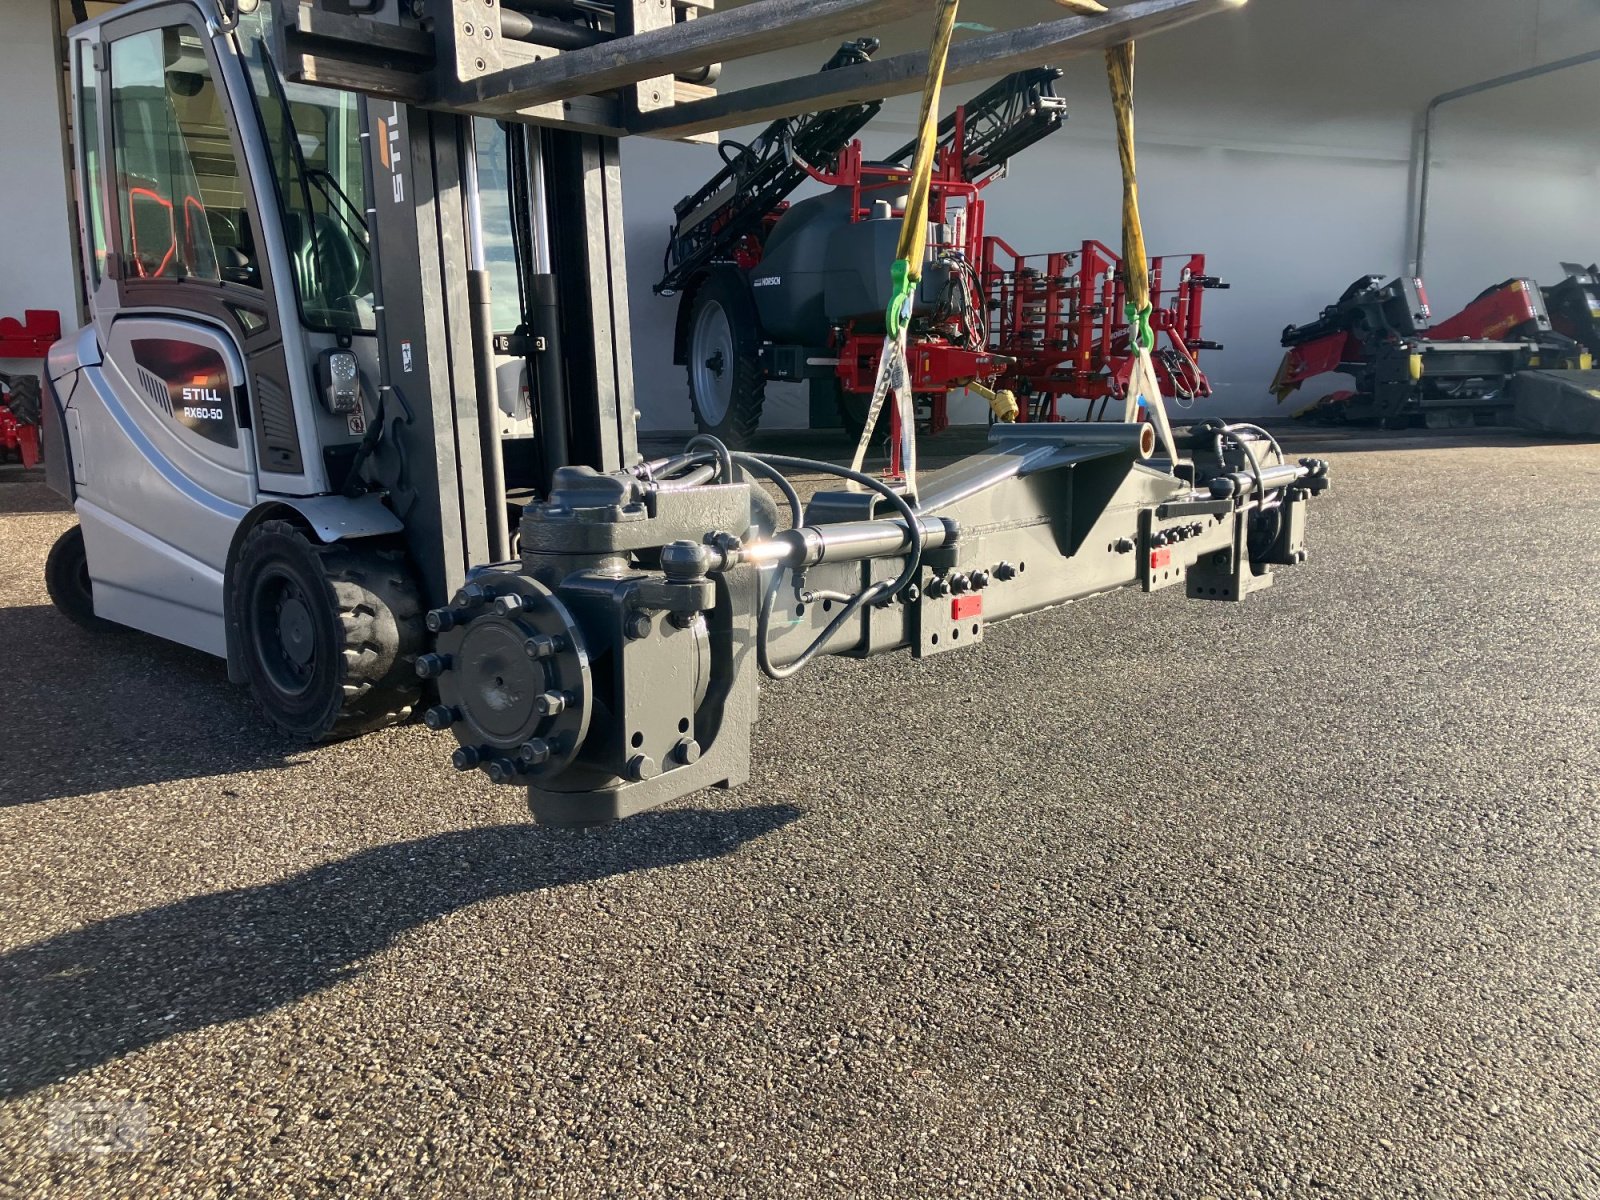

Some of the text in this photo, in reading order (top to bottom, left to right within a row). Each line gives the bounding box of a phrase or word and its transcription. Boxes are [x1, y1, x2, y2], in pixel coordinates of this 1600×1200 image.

[387, 101, 404, 203] STIL
[182, 387, 222, 402] STILL
[183, 406, 223, 420] RX60-50
